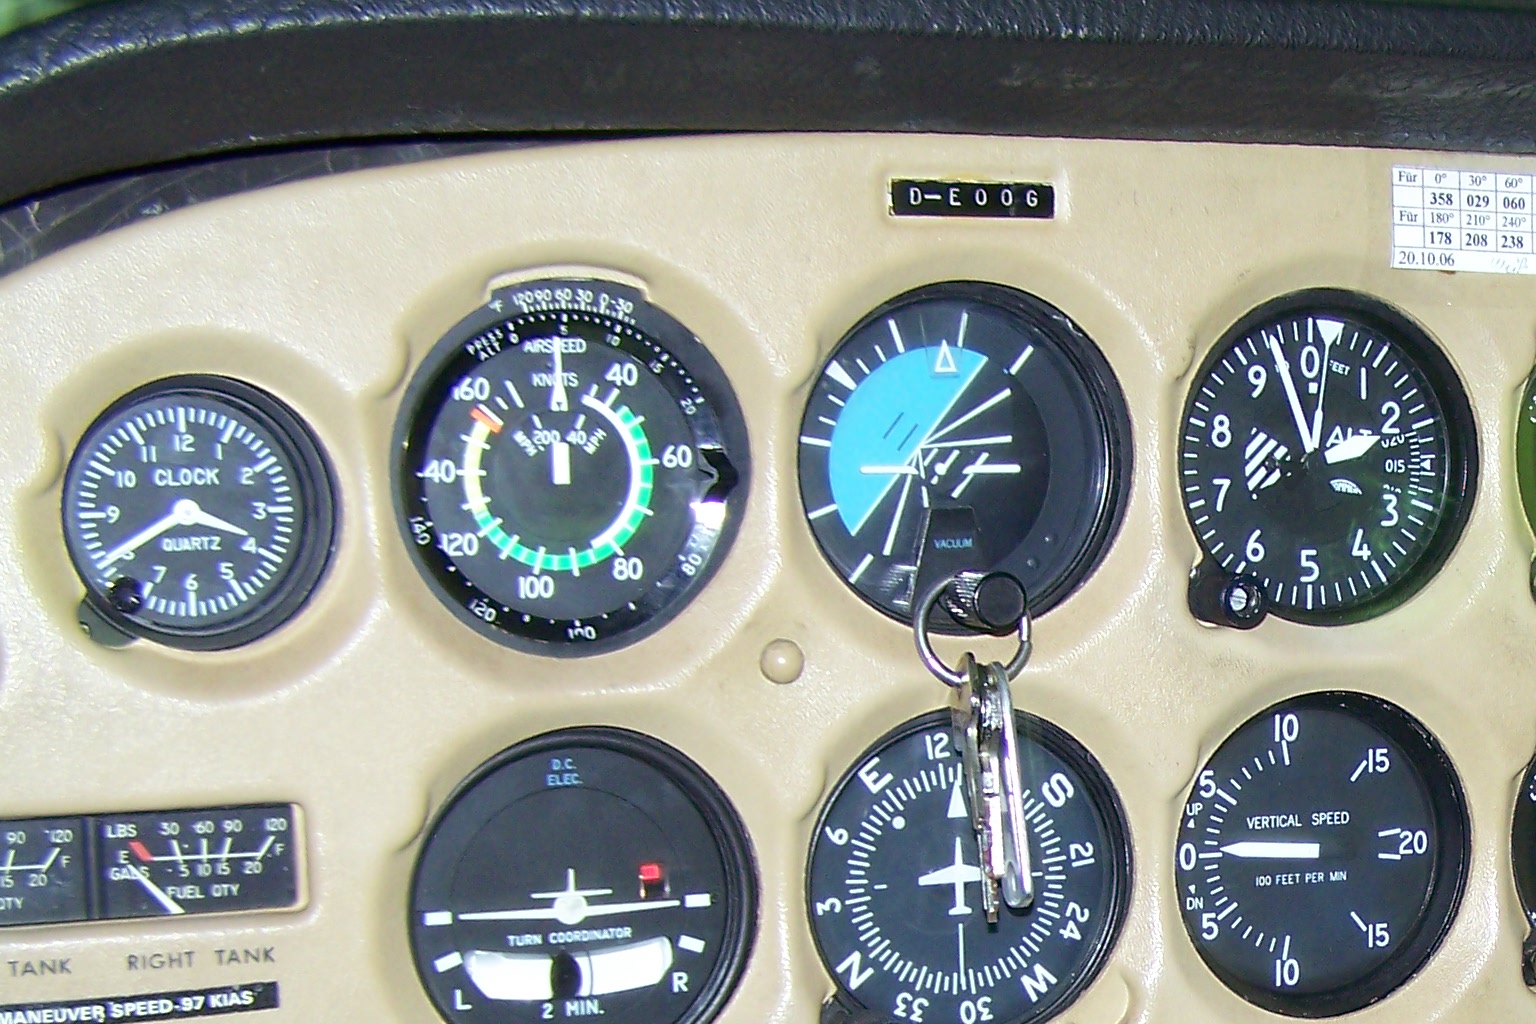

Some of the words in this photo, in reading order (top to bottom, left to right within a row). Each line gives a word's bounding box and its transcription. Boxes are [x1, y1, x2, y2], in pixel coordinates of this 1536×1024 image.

[1398, 172, 1418, 184] Für
[1430, 192, 1453, 206] 358
[1467, 194, 1489, 208] 029
[1503, 196, 1526, 210] 060
[1430, 231, 1452, 246] 178
[1465, 233, 1488, 247] 208
[1501, 235, 1524, 250] 238
[1398, 252, 1455, 268] 20.10.06
[174, 434, 195, 452] 12
[155, 467, 219, 486] CLOCK
[162, 536, 221, 552] QUARTZ
[934, 537, 973, 549] VACUUM
[612, 557, 643, 581] 80
[1299, 549, 1320, 582] 5
[518, 575, 554, 599] 100
[925, 732, 952, 761] 12
[552, 759, 577, 771] D.C.
[1367, 748, 1391, 774] 15
[1186, 802, 1203, 816] UP
[195, 820, 215, 834] 60
[223, 818, 243, 832] 90
[265, 817, 288, 831] 120
[1246, 814, 1303, 830] VERTICAL
[1311, 811, 1350, 826] SPEED
[105, 823, 138, 839] LBS
[1399, 830, 1427, 854] 20
[1255, 875, 1272, 887] 100
[1275, 873, 1300, 886] FEET
[1305, 872, 1325, 884] PER
[1329, 871, 1347, 882] MIN
[168, 885, 205, 899] FUEL
[211, 883, 241, 897] QTY
[1186, 896, 1204, 910] DN
[507, 933, 542, 947] TURN
[549, 926, 632, 944] COORDINATOR
[8, 957, 72, 978] TANK
[127, 951, 195, 972] RIGHT
[214, 947, 277, 966] TANK
[835, 950, 876, 991] N
[1020, 962, 1058, 1003] W
[211, 989, 254, 1009] KIAS
[566, 1000, 605, 1016] MIN.
